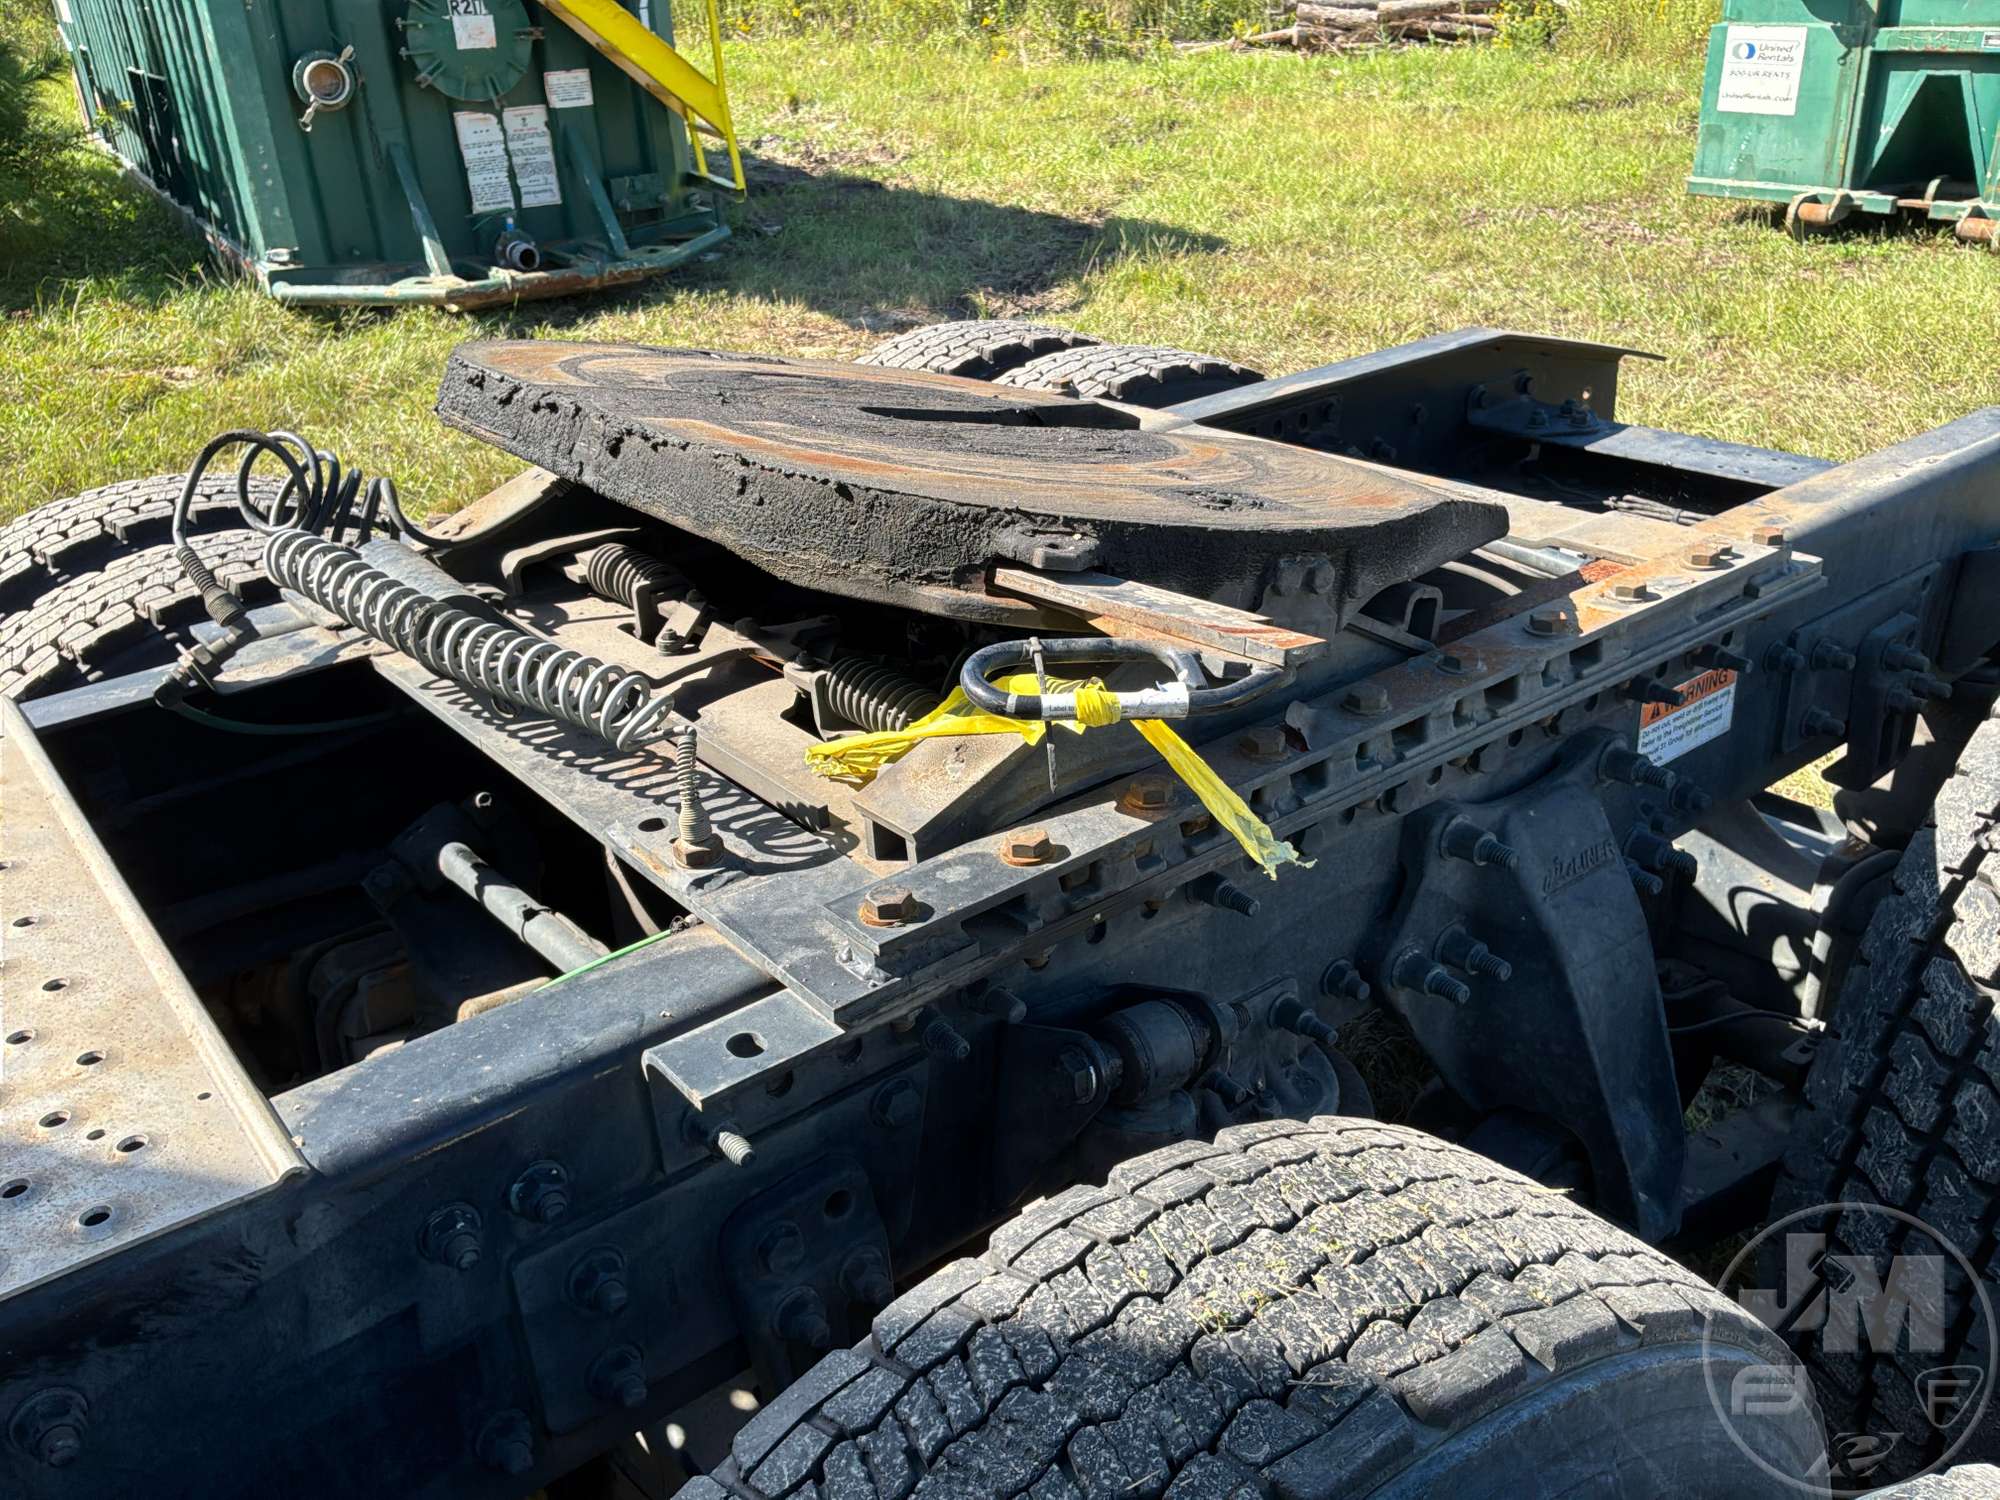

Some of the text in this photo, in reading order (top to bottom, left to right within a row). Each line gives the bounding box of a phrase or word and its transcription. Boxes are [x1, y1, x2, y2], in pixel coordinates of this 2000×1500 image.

[1759, 42, 1794, 53] United
[1757, 53, 1794, 63] Rentals
[1664, 669, 1728, 712] RNING
[1049, 704, 1067, 712] Label
